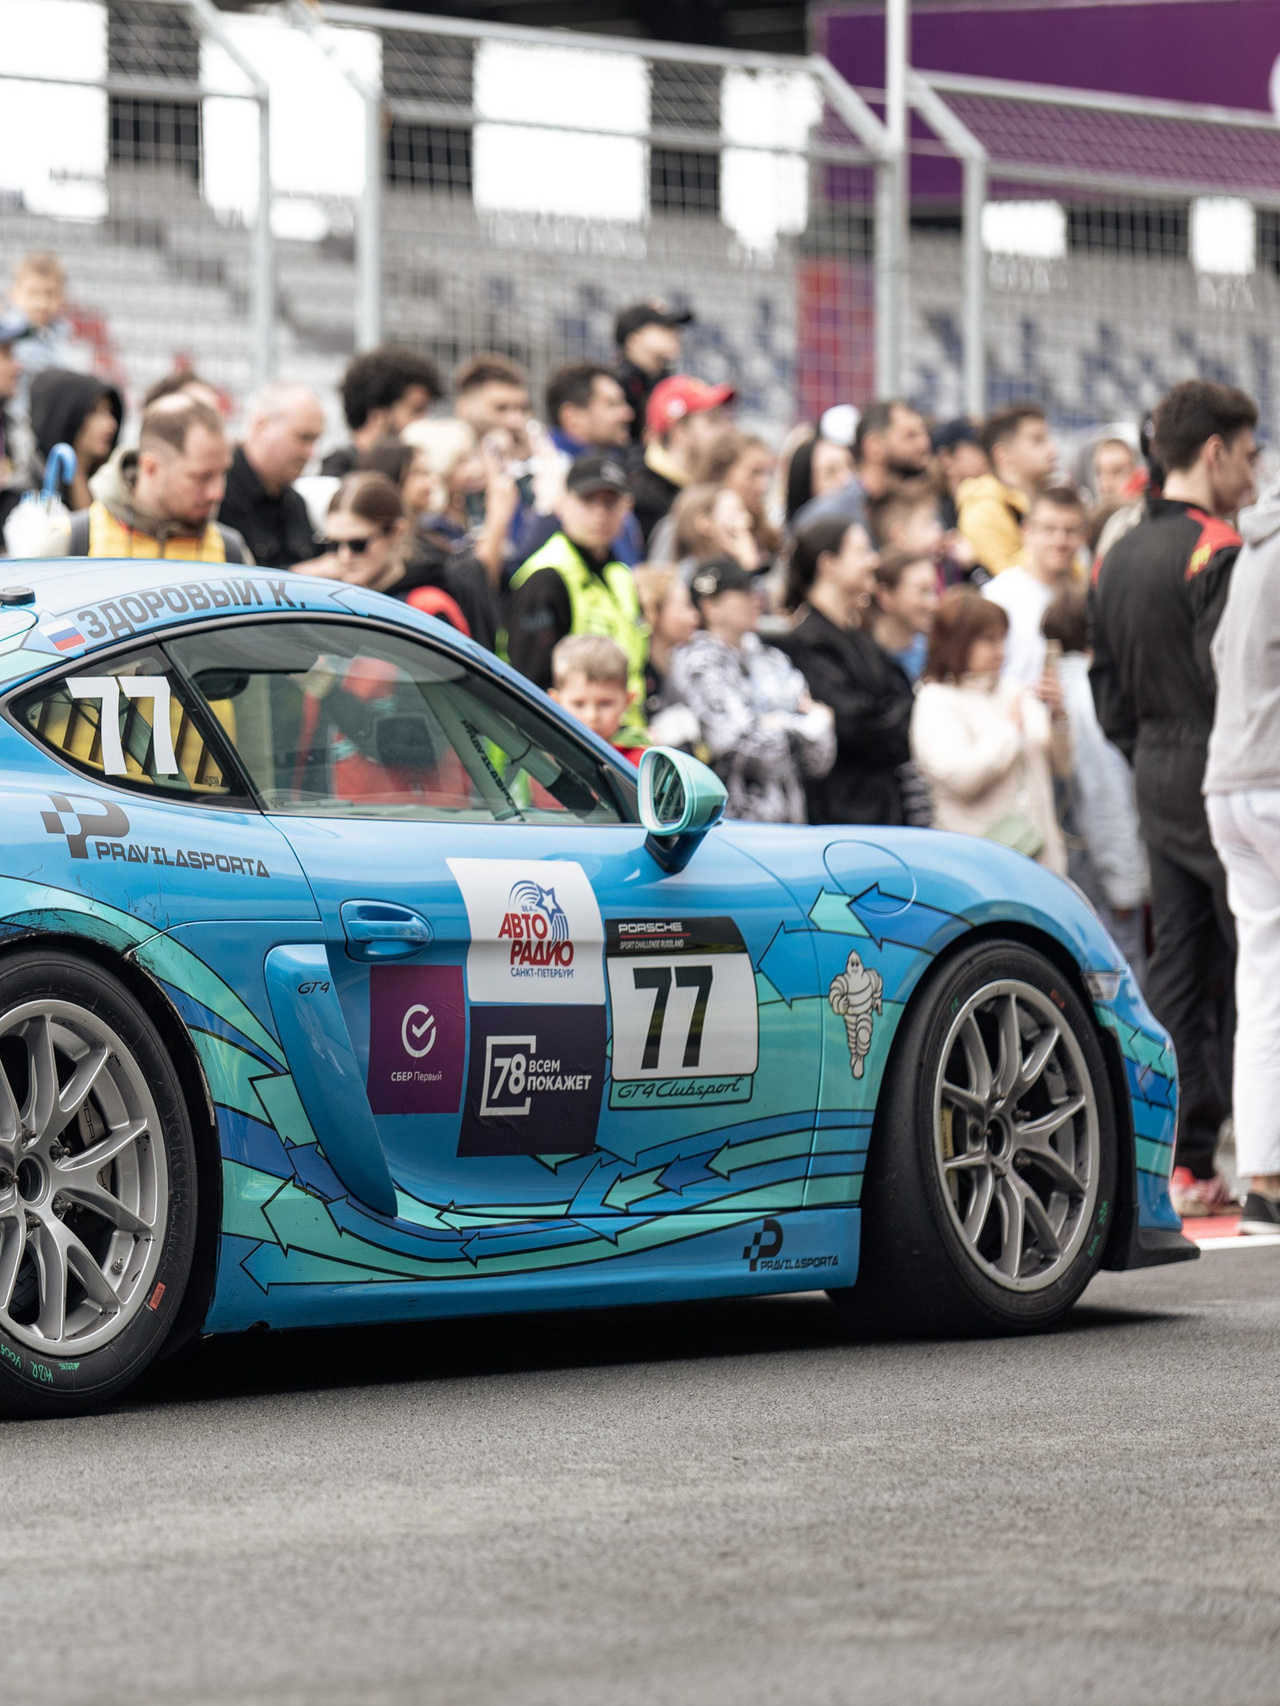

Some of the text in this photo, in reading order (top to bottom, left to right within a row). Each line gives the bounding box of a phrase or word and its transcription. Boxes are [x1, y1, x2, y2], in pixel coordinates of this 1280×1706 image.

[77, 576, 261, 640] ЗДОРОВЫЙ
[65, 676, 179, 775] 77
[95, 841, 271, 878] PRAVILASPORTA
[498, 913, 548, 940] АВТО
[618, 922, 683, 934] PORSCHE
[510, 940, 574, 967] РАДИО
[510, 967, 575, 978] САНКТ-ПЕТЕРБУРГ
[298, 981, 330, 994] GT4
[633, 965, 714, 1070] 77
[391, 1070, 442, 1083] СБЕР Первый
[491, 1053, 527, 1099] 78
[527, 1075, 592, 1091] ПОКАЖЕТ
[618, 1077, 744, 1100] GT4 Clubsport
[760, 1255, 839, 1271] PRAVILASPORTA
